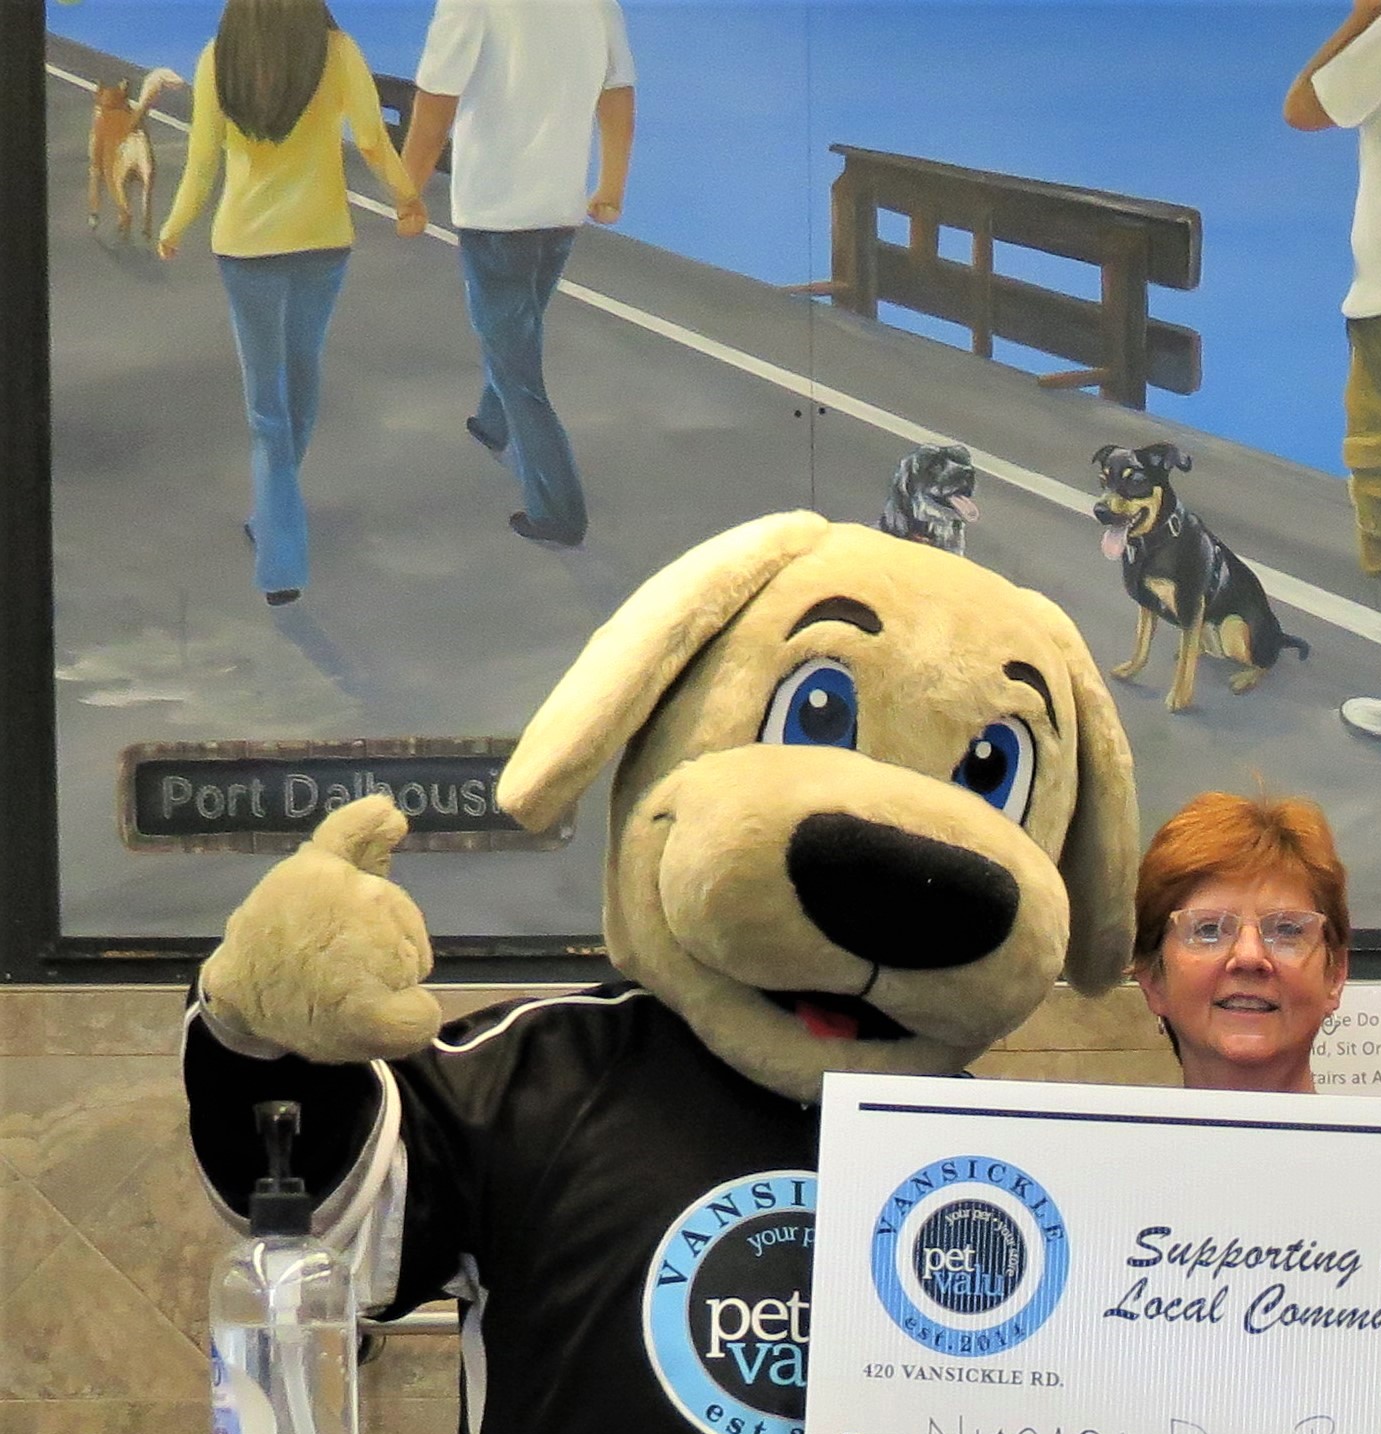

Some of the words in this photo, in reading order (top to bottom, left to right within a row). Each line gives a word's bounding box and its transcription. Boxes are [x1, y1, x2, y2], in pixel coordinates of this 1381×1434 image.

[161, 774, 267, 819] Port
[283, 769, 501, 818] Dalhousi
[1357, 1012, 1379, 1026] Do
[1311, 1041, 1331, 1058] nd,
[1336, 1041, 1357, 1055] Sit
[1362, 1041, 1381, 1055] Or
[1311, 1071, 1346, 1084] tairs
[1351, 1072, 1367, 1084] at
[877, 1159, 1064, 1243] VANSICKLE
[657, 1180, 806, 1289] VANSI
[746, 1224, 799, 1257] your
[922, 1243, 976, 1280] pet
[1126, 1226, 1364, 1289] Supporting
[933, 1263, 1005, 1296] valu
[1102, 1277, 1230, 1324] Local
[705, 1290, 810, 1358] pet
[726, 1341, 807, 1387] va
[862, 1363, 894, 1379] 420
[901, 1364, 1024, 1385] VANSICKLE
[1030, 1371, 1065, 1388] RD.
